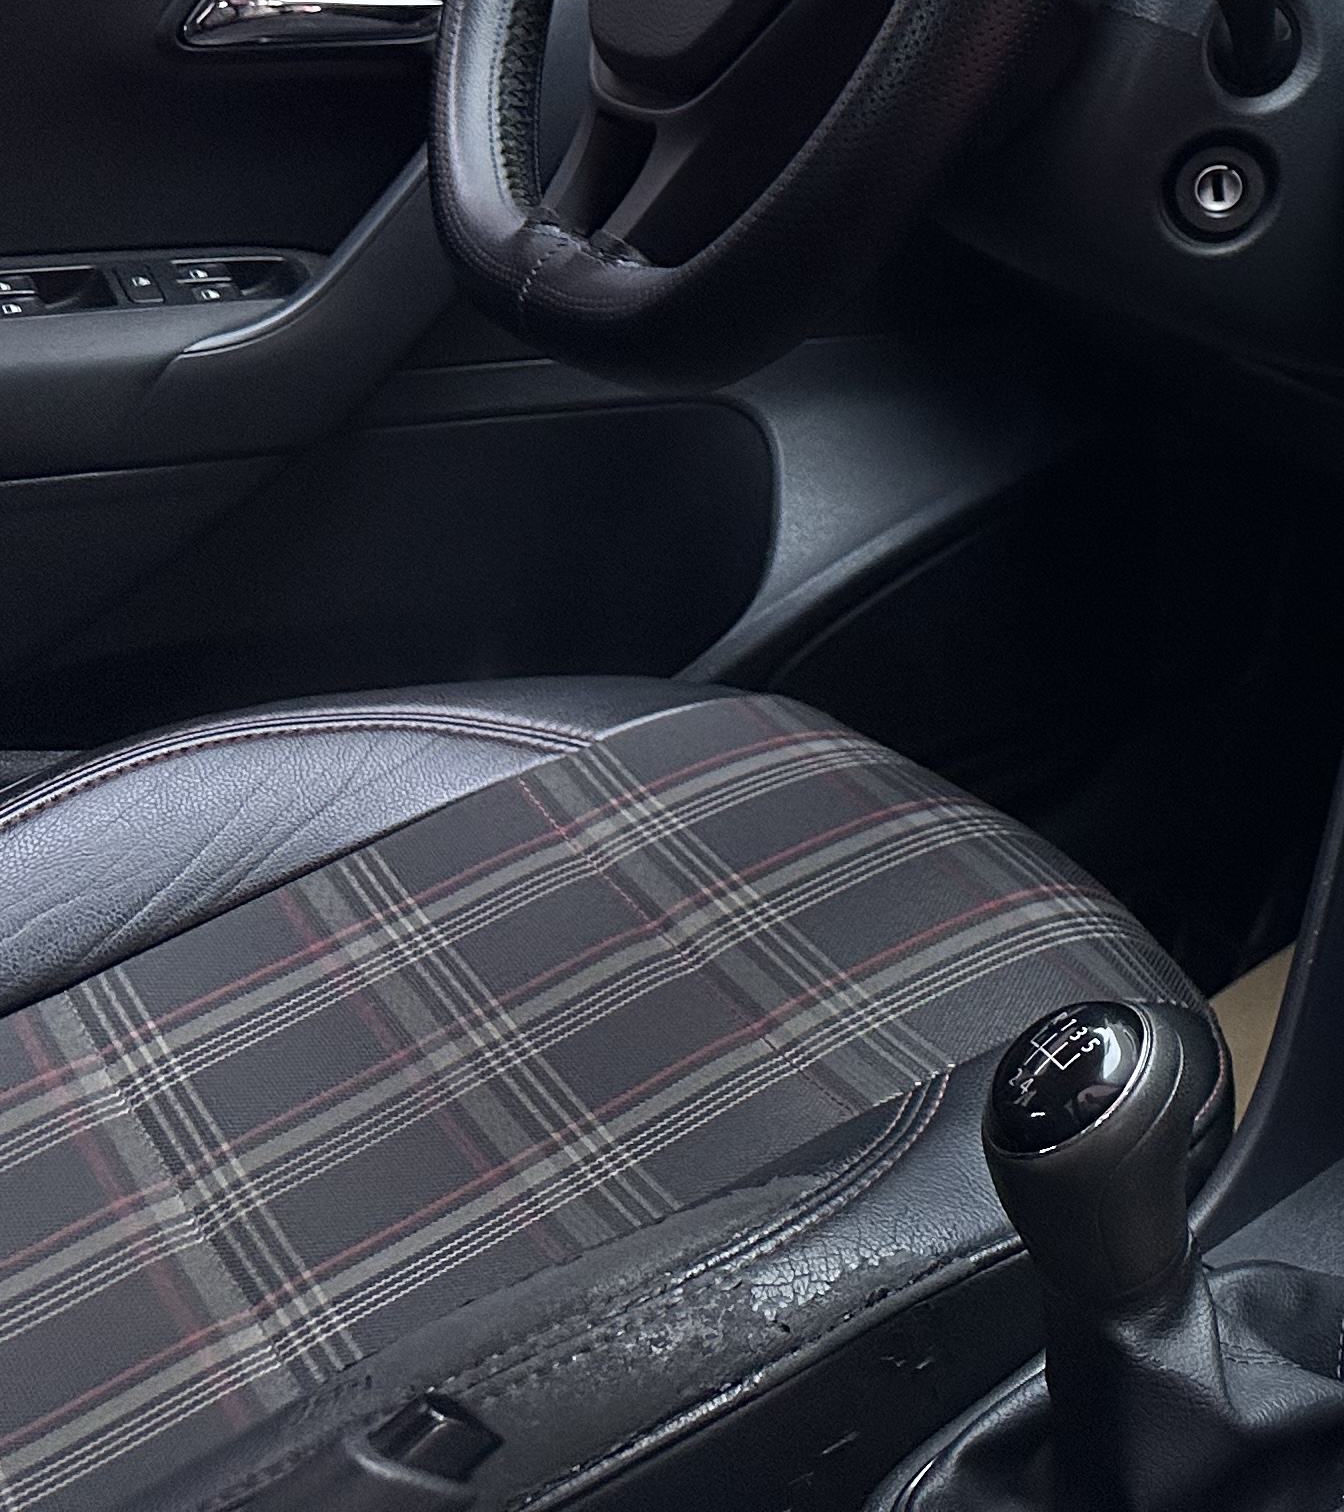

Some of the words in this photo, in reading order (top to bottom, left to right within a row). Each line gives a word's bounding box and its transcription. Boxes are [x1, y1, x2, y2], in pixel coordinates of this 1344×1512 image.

[1070, 1026, 1088, 1040] 3
[1080, 1037, 1101, 1052] 5
[1020, 1078, 1034, 1095] 4
